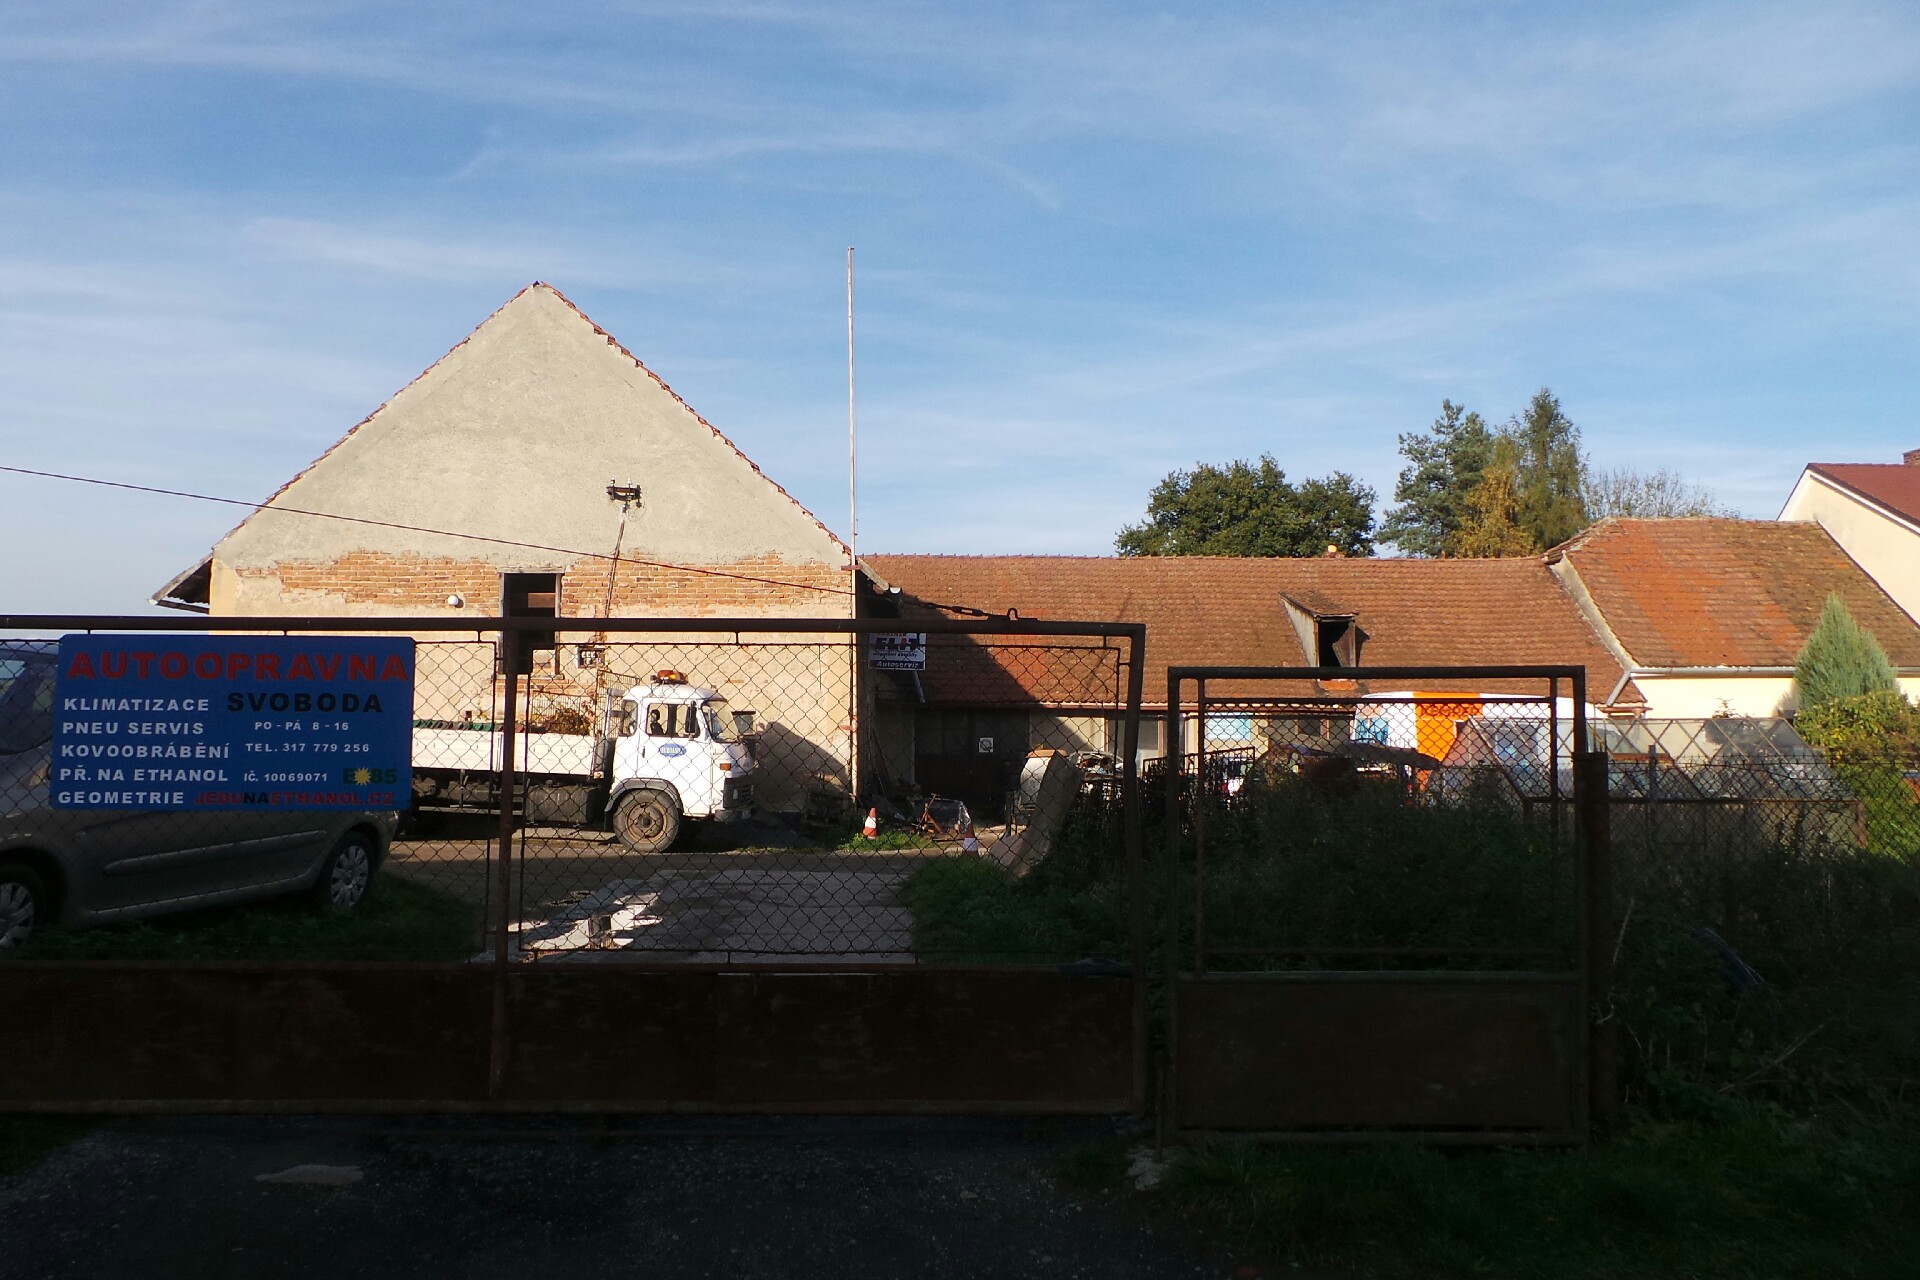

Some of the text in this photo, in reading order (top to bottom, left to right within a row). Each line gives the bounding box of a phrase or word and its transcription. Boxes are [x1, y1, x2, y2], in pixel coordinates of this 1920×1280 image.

[66, 652, 409, 682] AUTOOPRAVNA
[63, 698, 209, 712] KLIMATIZACE
[227, 692, 383, 713] SVOBODA
[62, 721, 205, 736] PNEU SERVIS
[254, 721, 272, 731] PO
[285, 719, 302, 731] PÁ
[312, 721, 320, 731] 8
[334, 721, 349, 731] 16
[61, 742, 231, 759] KOVOOBRÁBĚNÍ
[245, 743, 370, 753] TEL. 317 779 256
[59, 764, 229, 782] PŘ. NA ETHANOL
[264, 772, 328, 783] 10069071
[58, 791, 185, 805] GEOMETRIE
